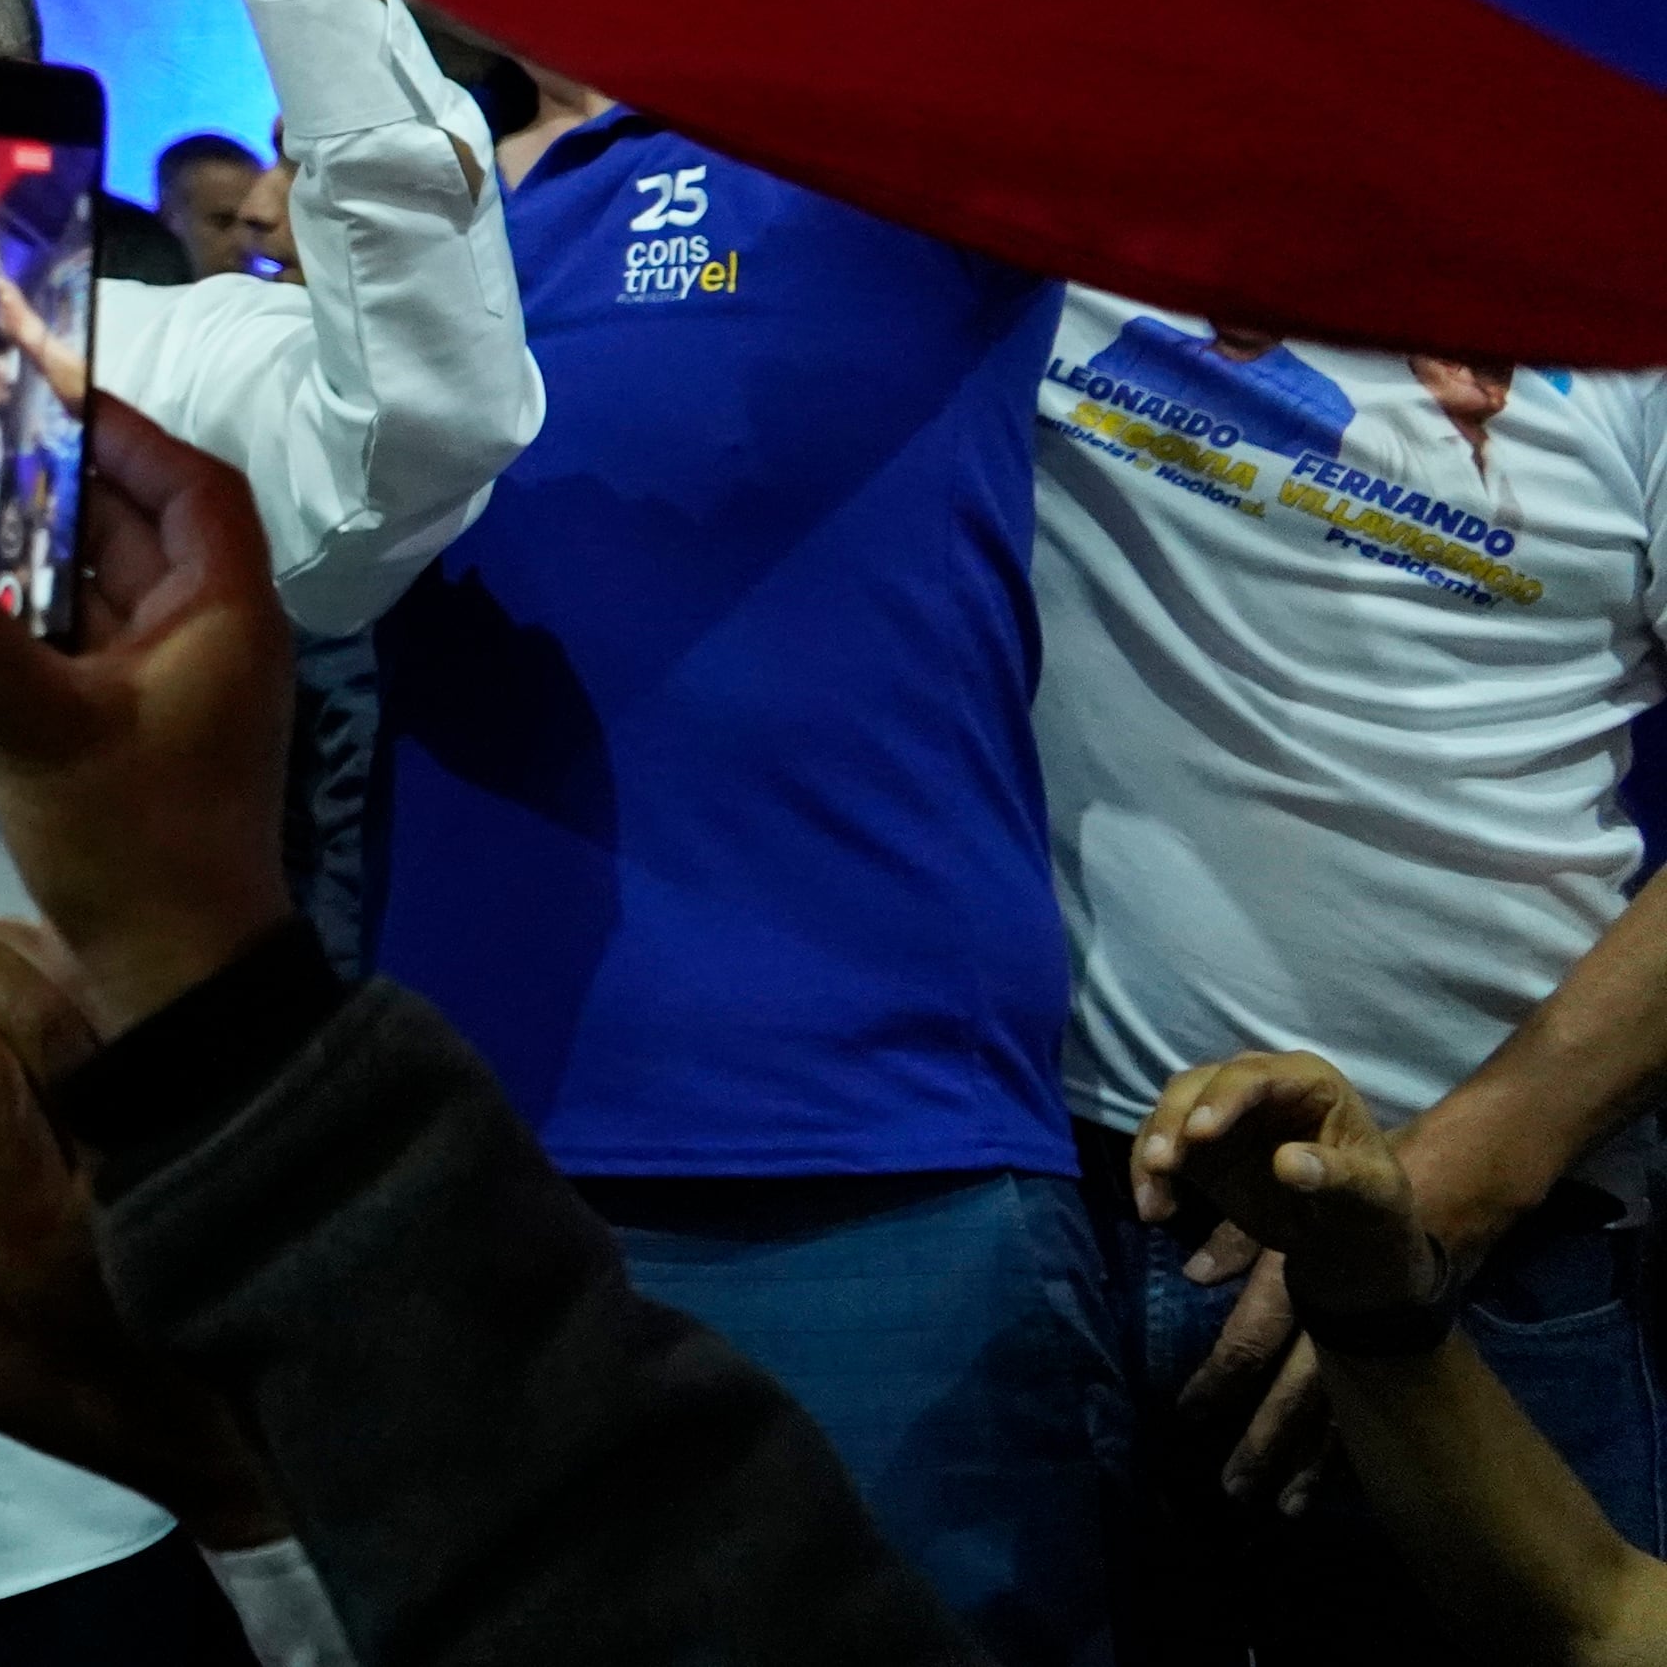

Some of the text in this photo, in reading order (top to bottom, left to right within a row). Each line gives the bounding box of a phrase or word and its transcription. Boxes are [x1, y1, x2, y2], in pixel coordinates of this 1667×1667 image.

[629, 164, 709, 232] 25
[623, 250, 739, 301] truyel
[625, 234, 711, 269] cons
[1046, 358, 1241, 449] LEONARDO
[1278, 479, 1544, 606] VILLAVICENCIO
[1292, 452, 1515, 558] FERNANDO
[1325, 527, 1495, 607] Presidente
